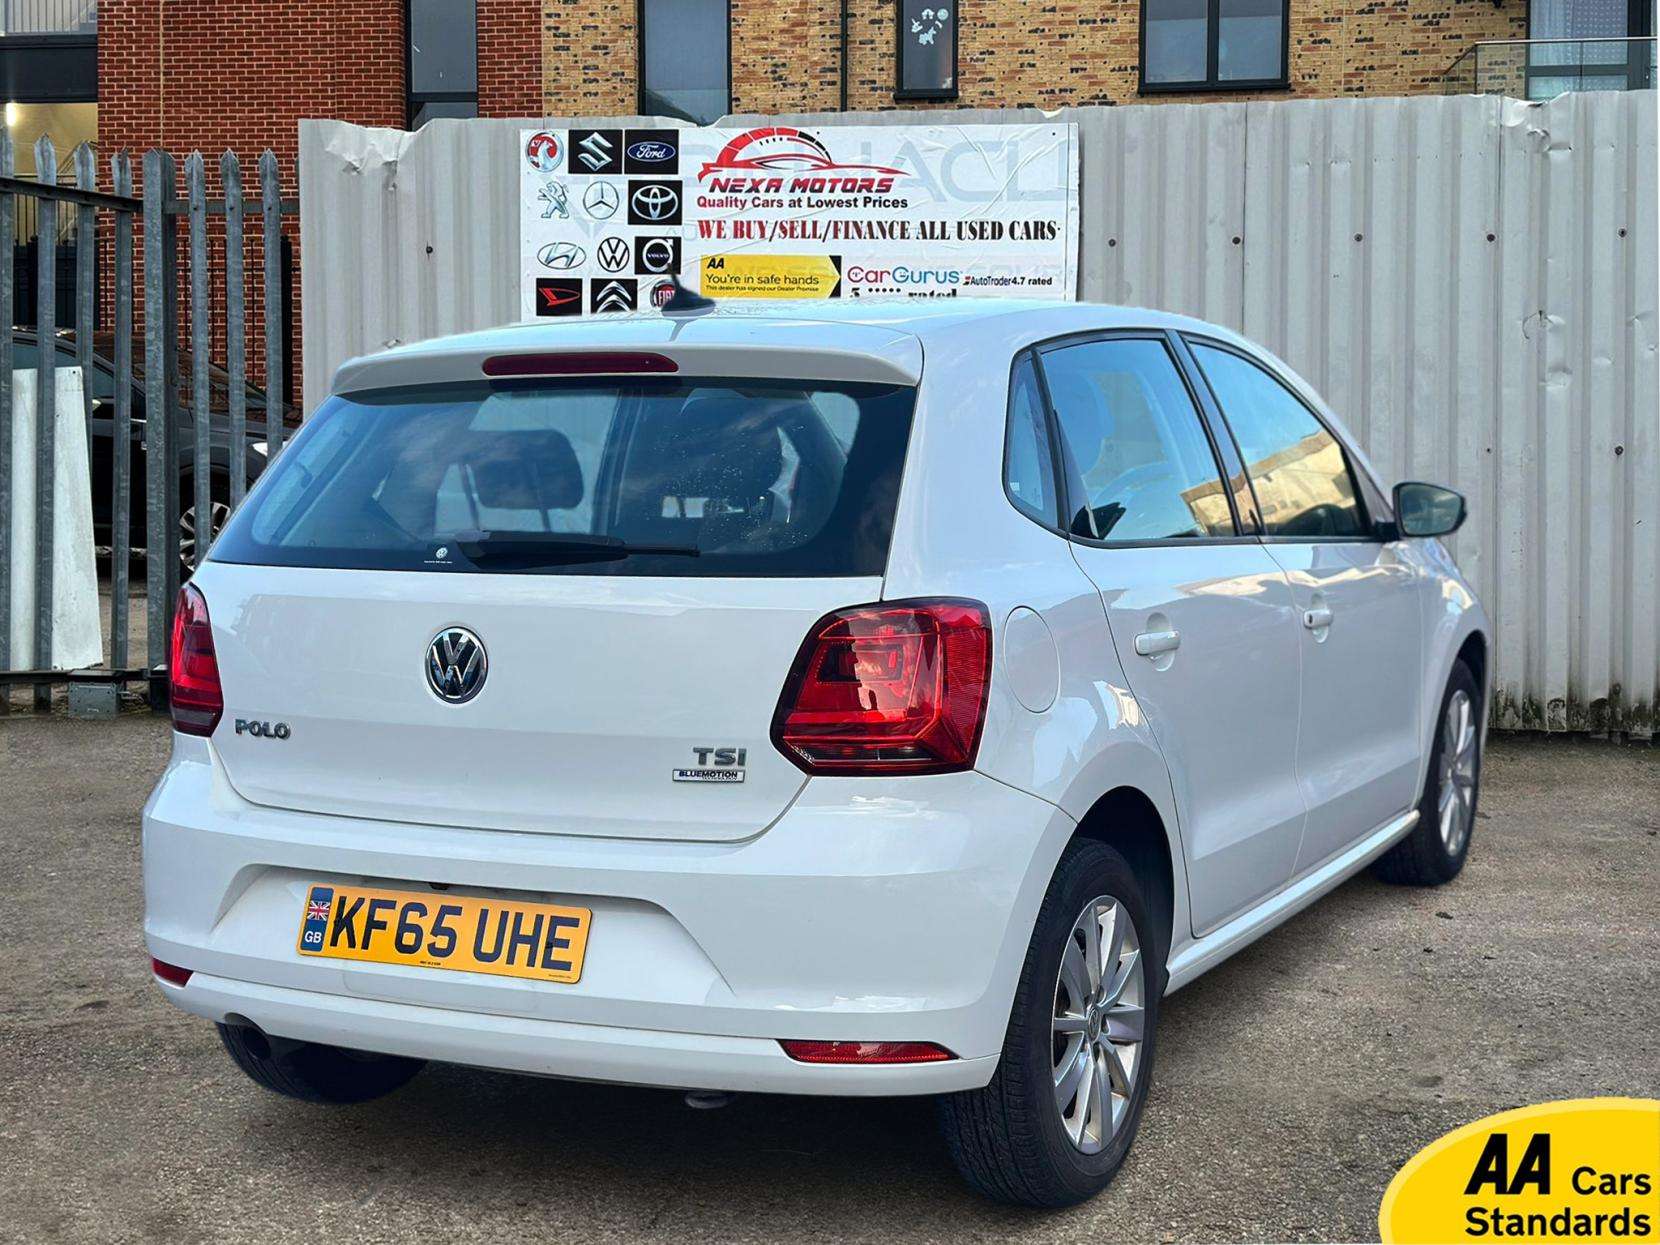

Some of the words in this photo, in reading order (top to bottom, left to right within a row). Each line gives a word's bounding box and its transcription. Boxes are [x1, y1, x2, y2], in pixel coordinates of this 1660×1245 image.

[636, 144, 666, 158] Ford
[709, 178, 784, 193] NEXA
[789, 177, 895, 193] MOTORS
[697, 196, 747, 210] Quality
[752, 196, 784, 208] Cars
[788, 197, 803, 208] at
[807, 197, 859, 208] Lowest
[863, 196, 908, 208] Prices
[697, 220, 727, 240] WE
[732, 219, 910, 243] BUY/SELL/FINANCE
[916, 220, 950, 240] ALL
[956, 220, 1004, 240] USED
[1008, 220, 1057, 240] CARS
[706, 257, 725, 269] AA
[706, 273, 741, 284] You're
[744, 273, 754, 284] in
[757, 273, 781, 284] safe
[784, 274, 819, 285] hands
[847, 266, 961, 283] CarGurus
[1028, 277, 1053, 286] rated
[235, 718, 291, 740] POLO
[693, 747, 747, 766] TSI
[679, 770, 738, 779] BLUEMOTION
[304, 930, 322, 944] GB
[329, 895, 463, 958] KF65
[472, 908, 580, 972] UHE
